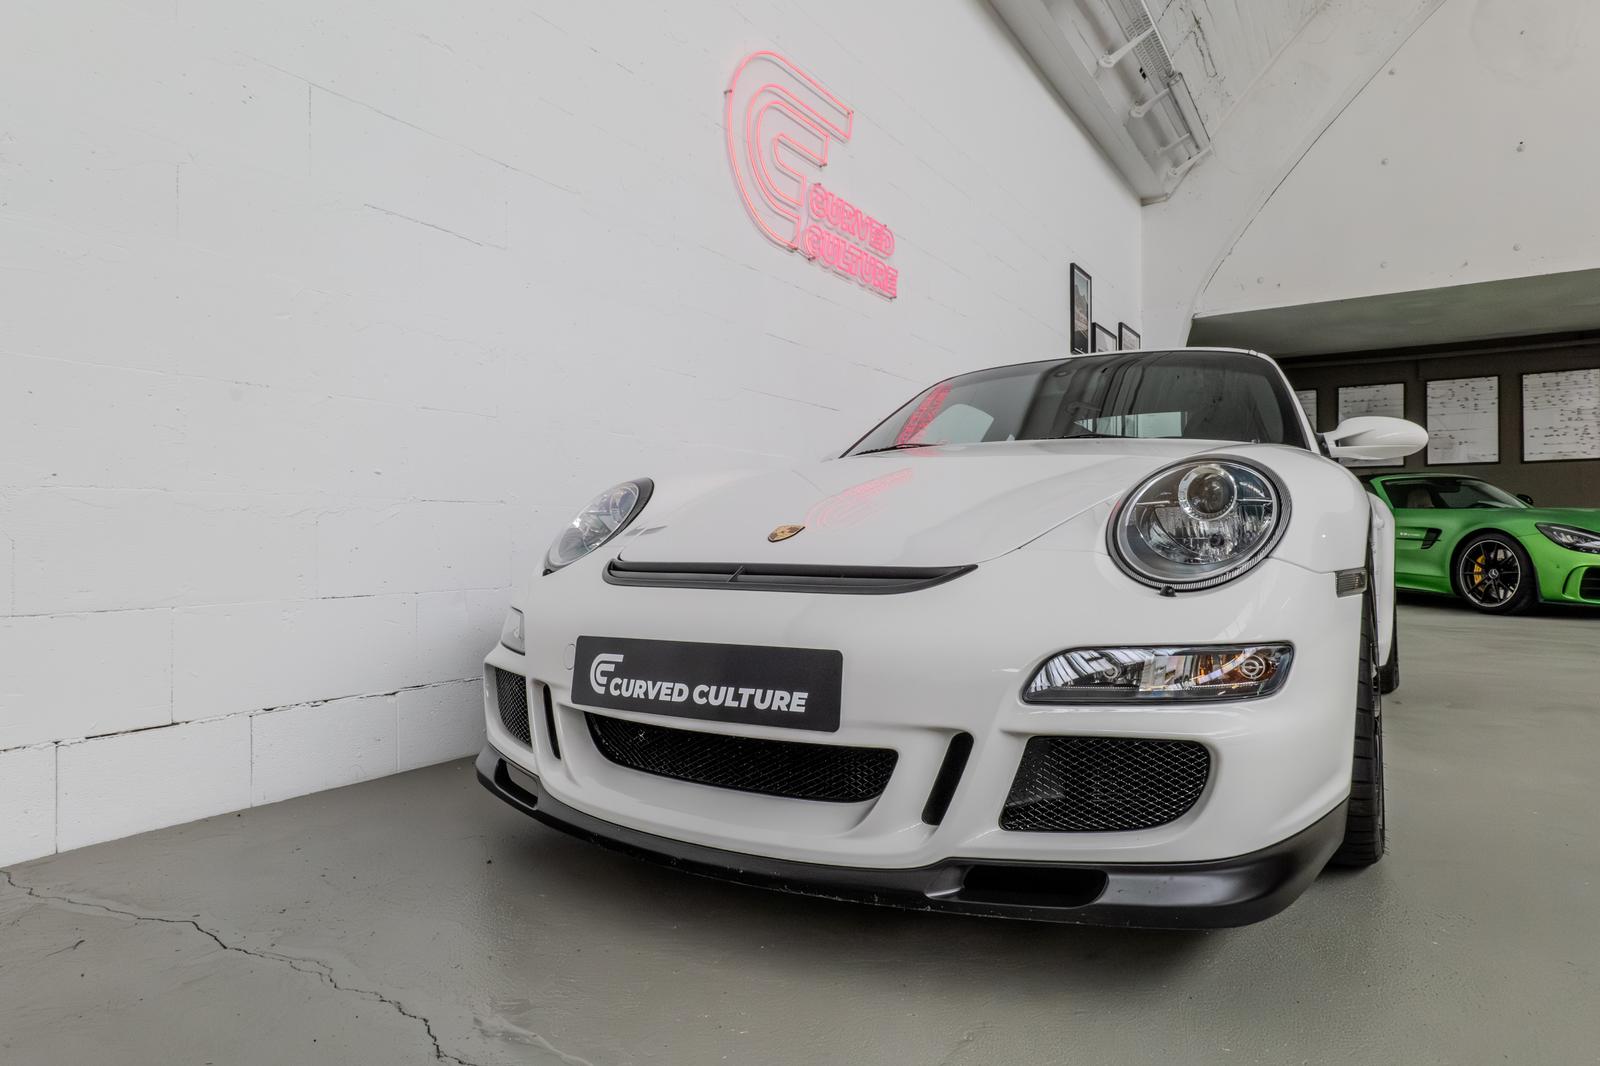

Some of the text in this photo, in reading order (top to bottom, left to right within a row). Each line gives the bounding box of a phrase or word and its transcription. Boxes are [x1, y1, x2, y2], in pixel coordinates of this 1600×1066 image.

[809, 183, 895, 257] CURVED
[804, 225, 898, 298] CULTURE
[609, 677, 809, 713] CURVED CULTURE
